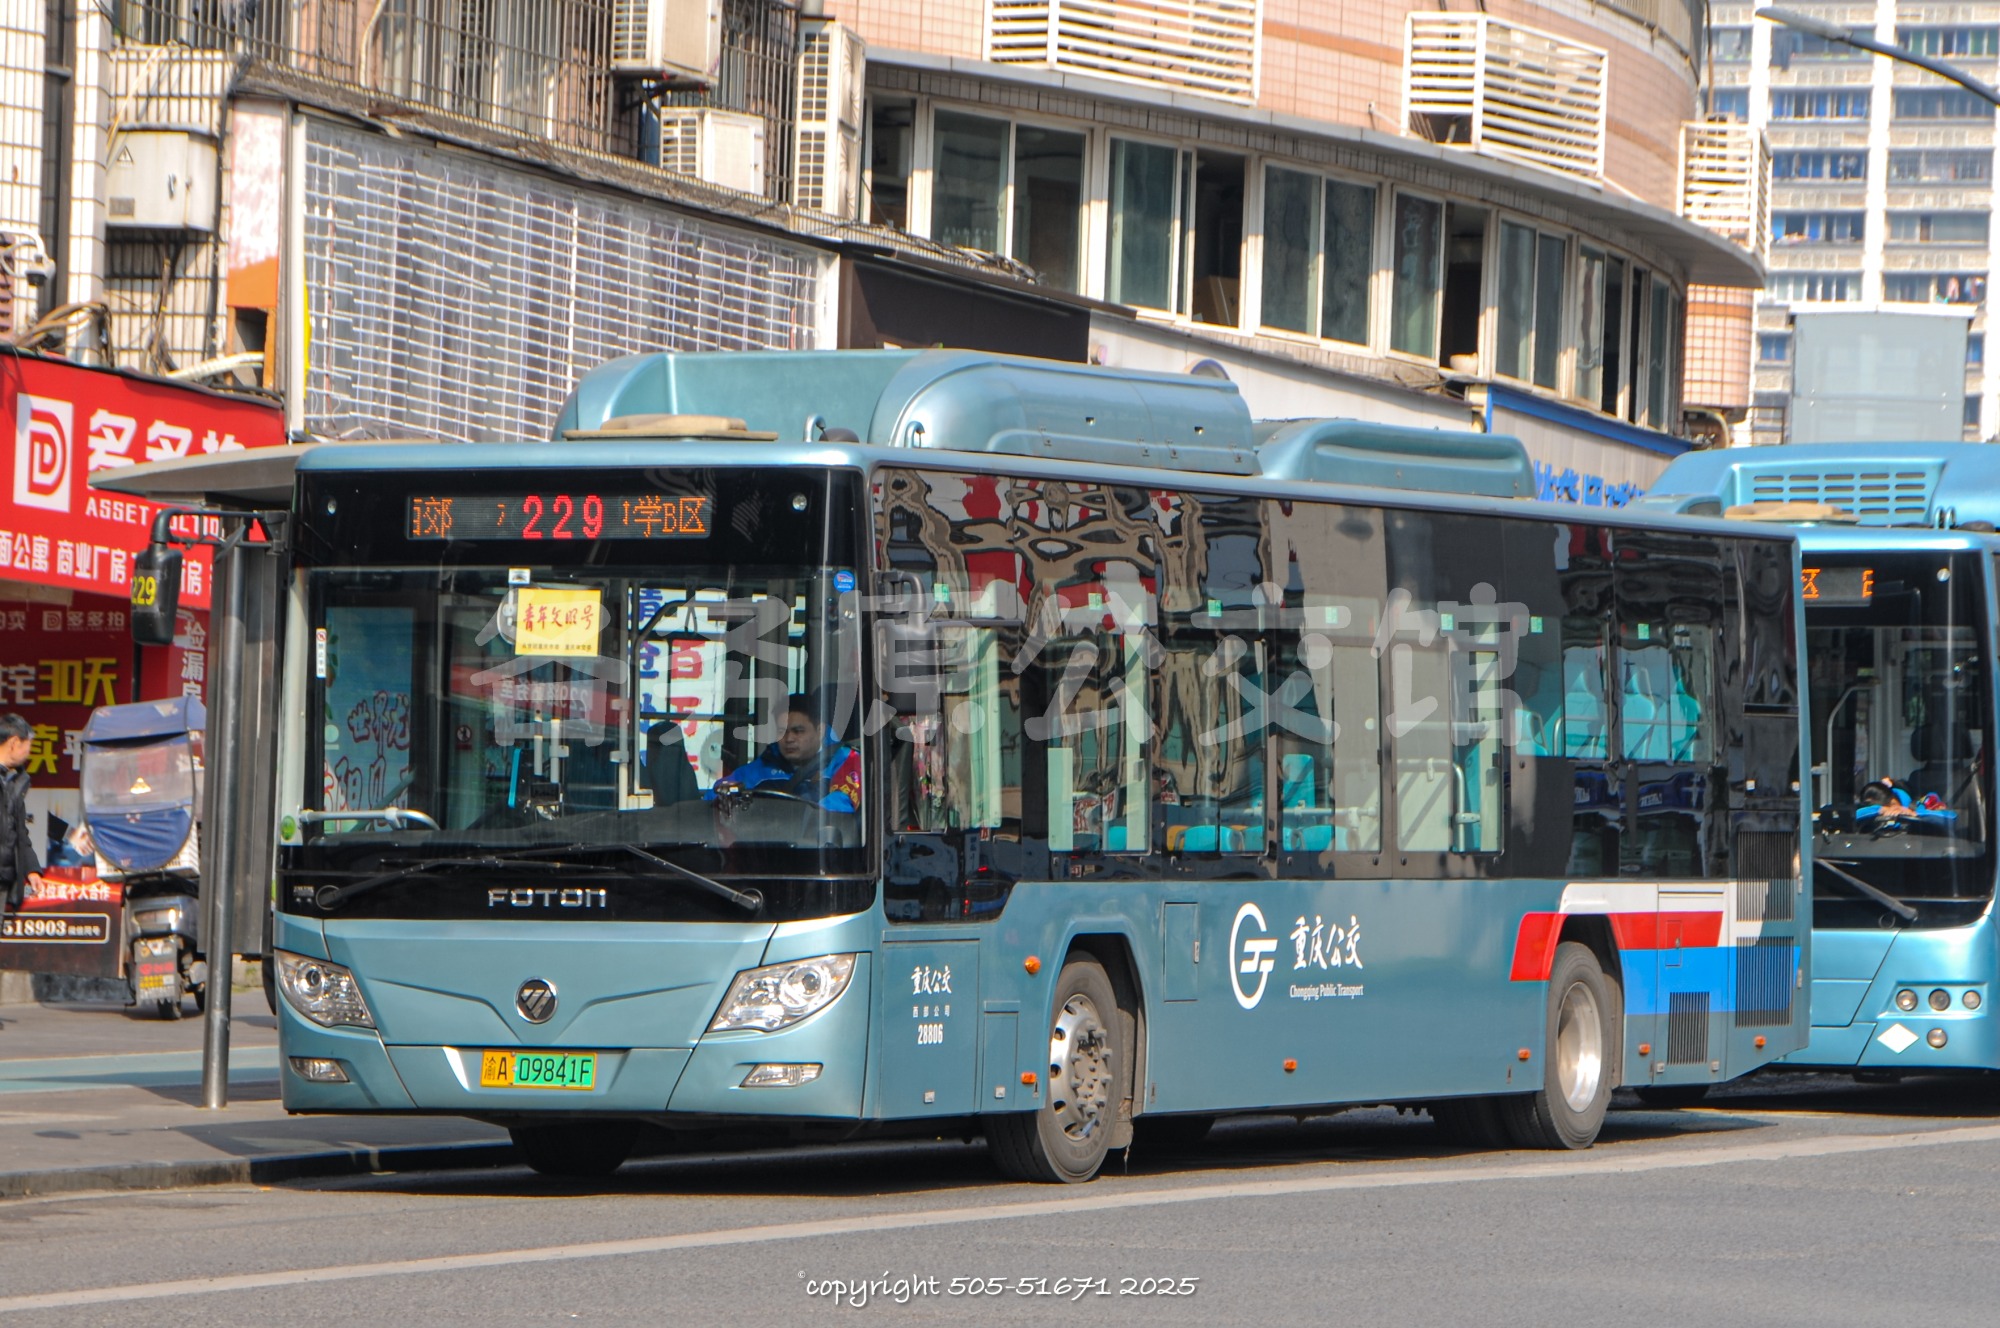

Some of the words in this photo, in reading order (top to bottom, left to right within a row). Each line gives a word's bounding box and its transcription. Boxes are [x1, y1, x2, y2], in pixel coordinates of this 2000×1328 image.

[85, 496, 149, 526] ASSET
[522, 495, 602, 538] 229
[57, 540, 127, 584] 商业厂房
[131, 576, 157, 606] 229
[67, 611, 125, 627] 多多拍
[523, 603, 594, 631] 青年文明号
[0, 657, 118, 706] 宅30天
[488, 889, 606, 907] FOTON
[2, 919, 67, 937] 518903
[1289, 915, 1363, 970] 重庆公交
[911, 965, 952, 995] 重庆公交
[1289, 984, 1319, 1001] Chongqing
[1320, 984, 1337, 997] Public
[1337, 983, 1364, 999] Transport
[917, 1024, 944, 1044] 28806
[519, 1058, 592, 1083] 09841F
